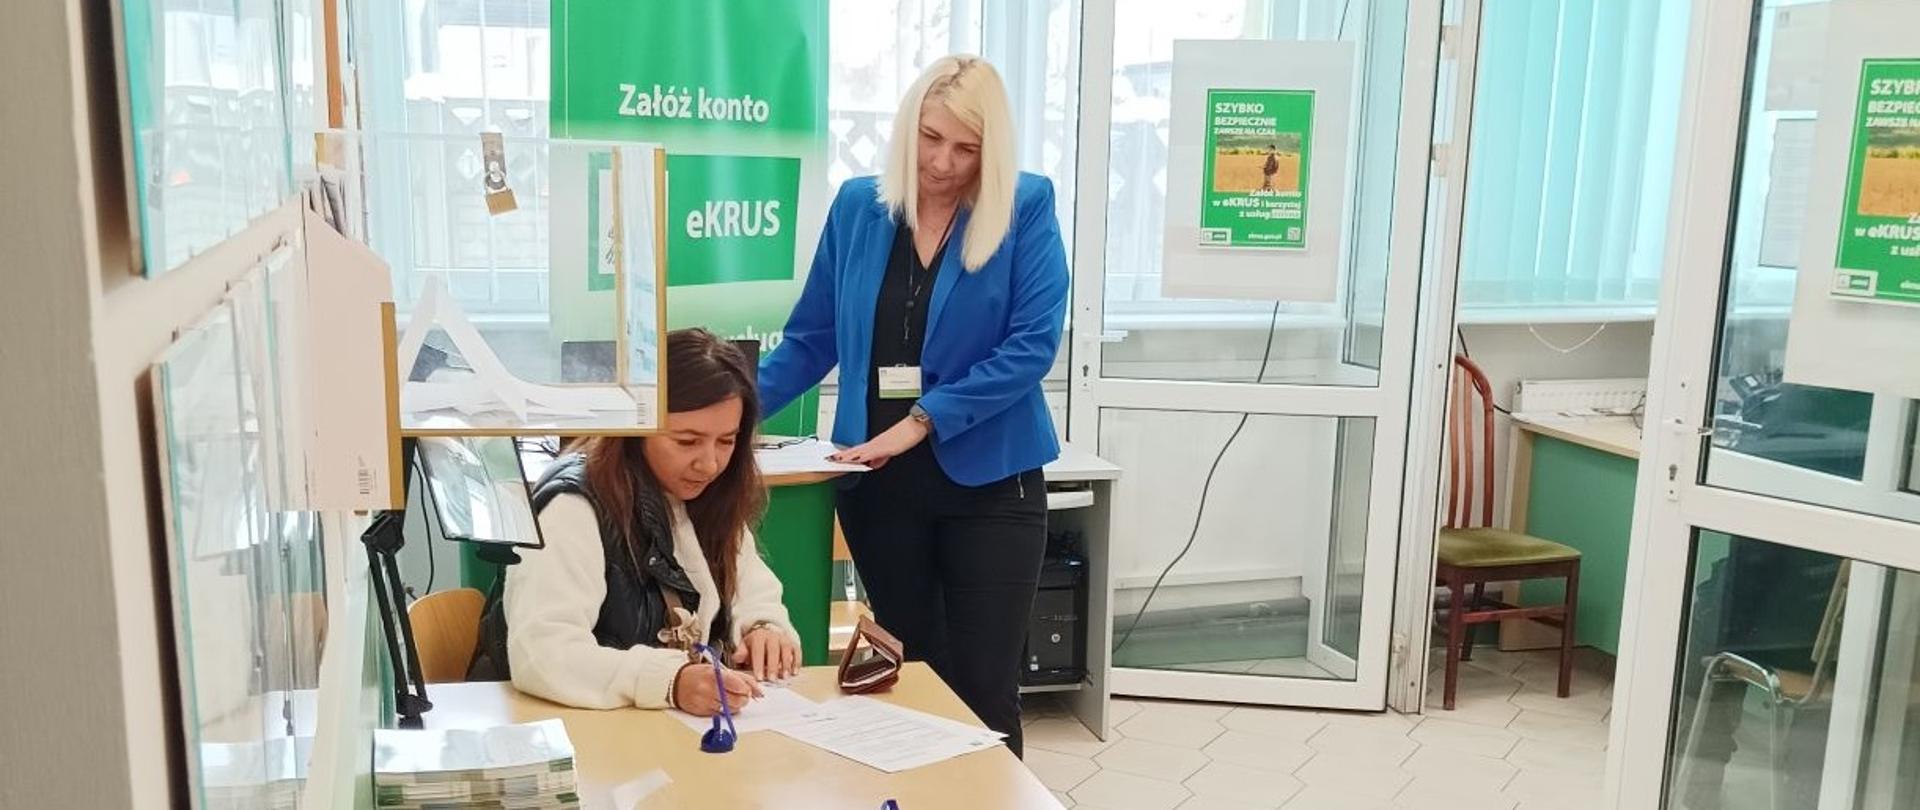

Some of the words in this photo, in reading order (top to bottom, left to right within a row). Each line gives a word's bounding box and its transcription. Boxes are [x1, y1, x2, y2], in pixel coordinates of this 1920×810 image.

[618, 83, 692, 118] Załóż
[697, 87, 769, 122] konto
[1215, 102, 1264, 113] SZYBKO
[1222, 197, 1260, 208] eKRUS
[686, 200, 780, 238] eKRUS
